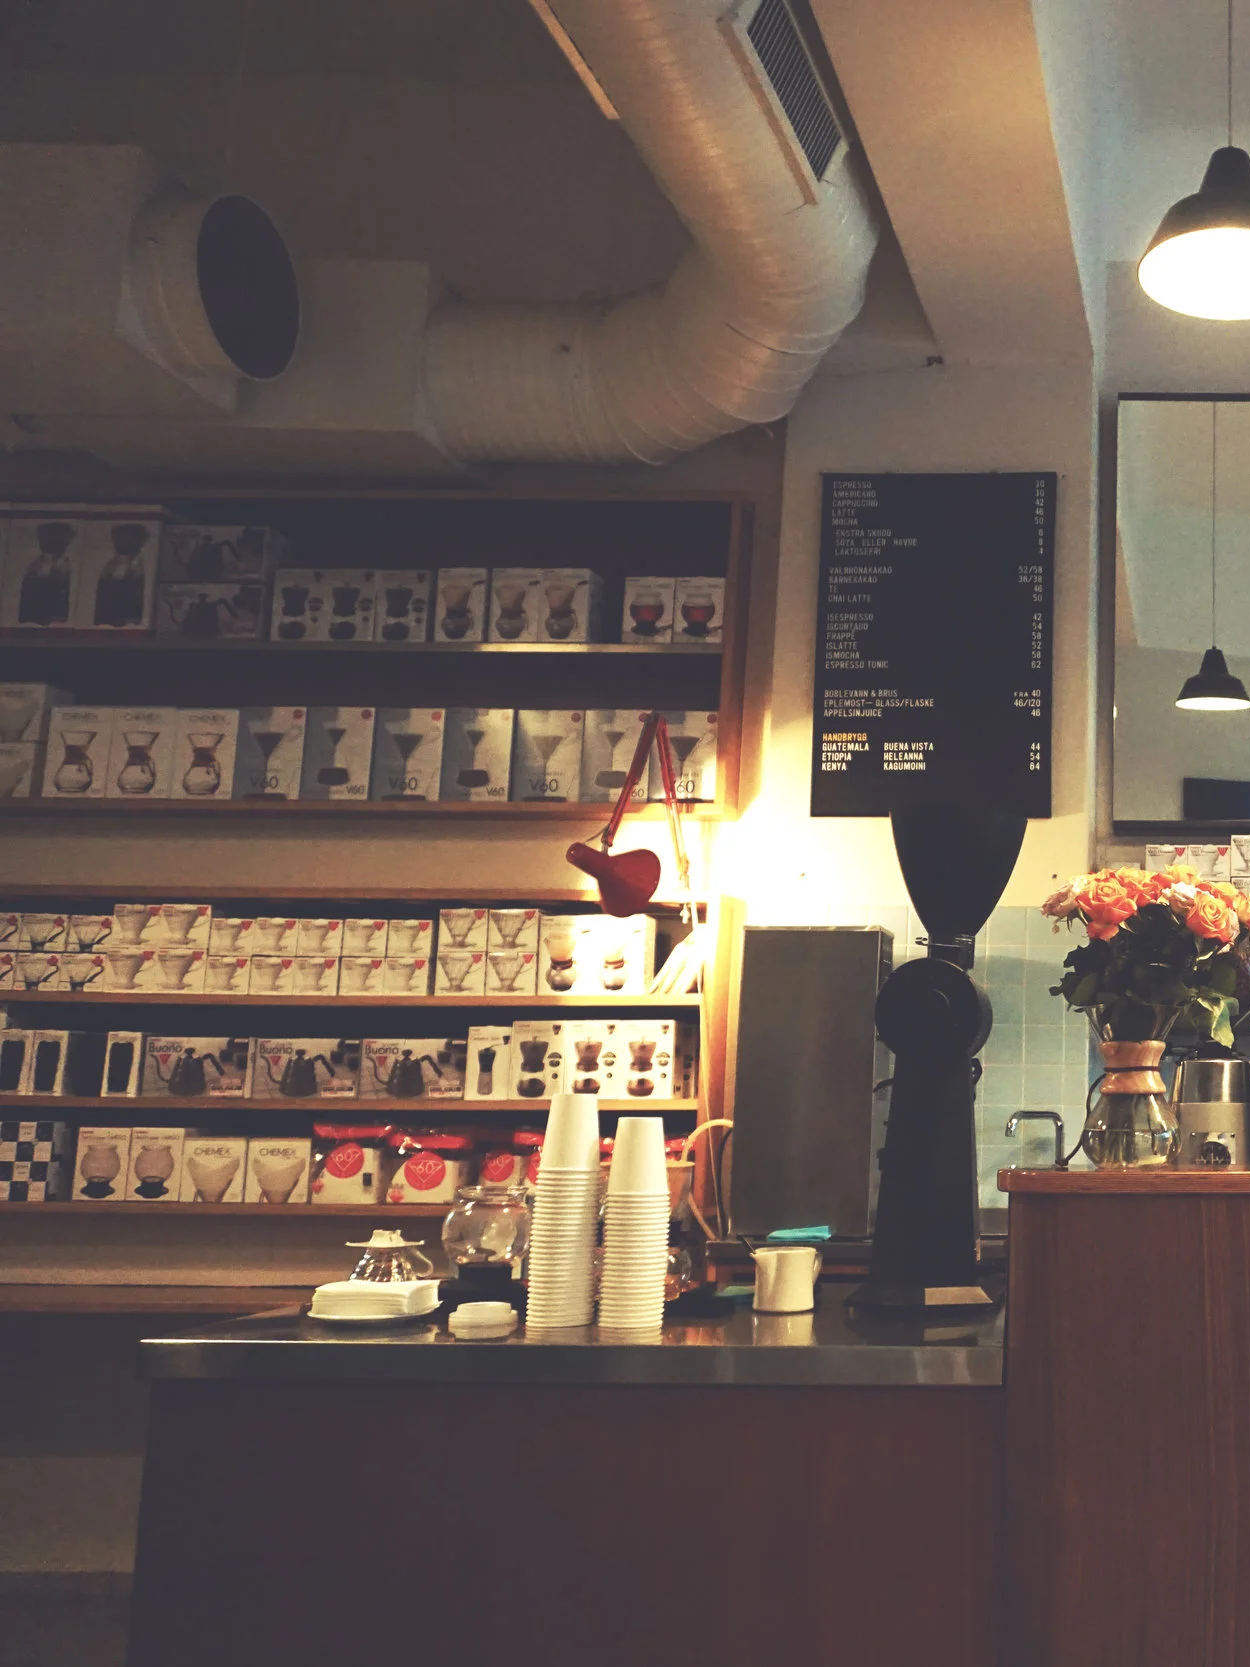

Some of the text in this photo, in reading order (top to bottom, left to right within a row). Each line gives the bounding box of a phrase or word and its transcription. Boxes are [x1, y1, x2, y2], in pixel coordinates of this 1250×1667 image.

[1033, 613, 1042, 621] 42
[1032, 622, 1042, 630] 54
[825, 641, 1042, 650] ISLATTE 52
[825, 651, 860, 659] ISMOCHA
[825, 660, 865, 669] ESPRESSO
[867, 660, 889, 669] TONIC
[878, 689, 898, 697] BRUS
[1031, 689, 1041, 697] 40
[823, 708, 882, 717] APPELSINJUICE
[822, 733, 867, 742] HANDBRYGG
[822, 742, 1041, 751] GUATEMALA BUENA VISTA 44
[821, 752, 1041, 761] ETIOPIA HELEANNA 54
[821, 762, 847, 771] KENYA
[883, 762, 926, 771] KAGUMOINI
[249, 775, 279, 789] V60
[388, 776, 417, 790] V60
[528, 779, 559, 793] V60
[486, 787, 505, 797] V60
[148, 1042, 182, 1053] Buono
[259, 1043, 293, 1055] Buono
[365, 1044, 399, 1056] Buono
[194, 1147, 231, 1157] CHEMEX
[259, 1147, 297, 1157] CHEMEX
